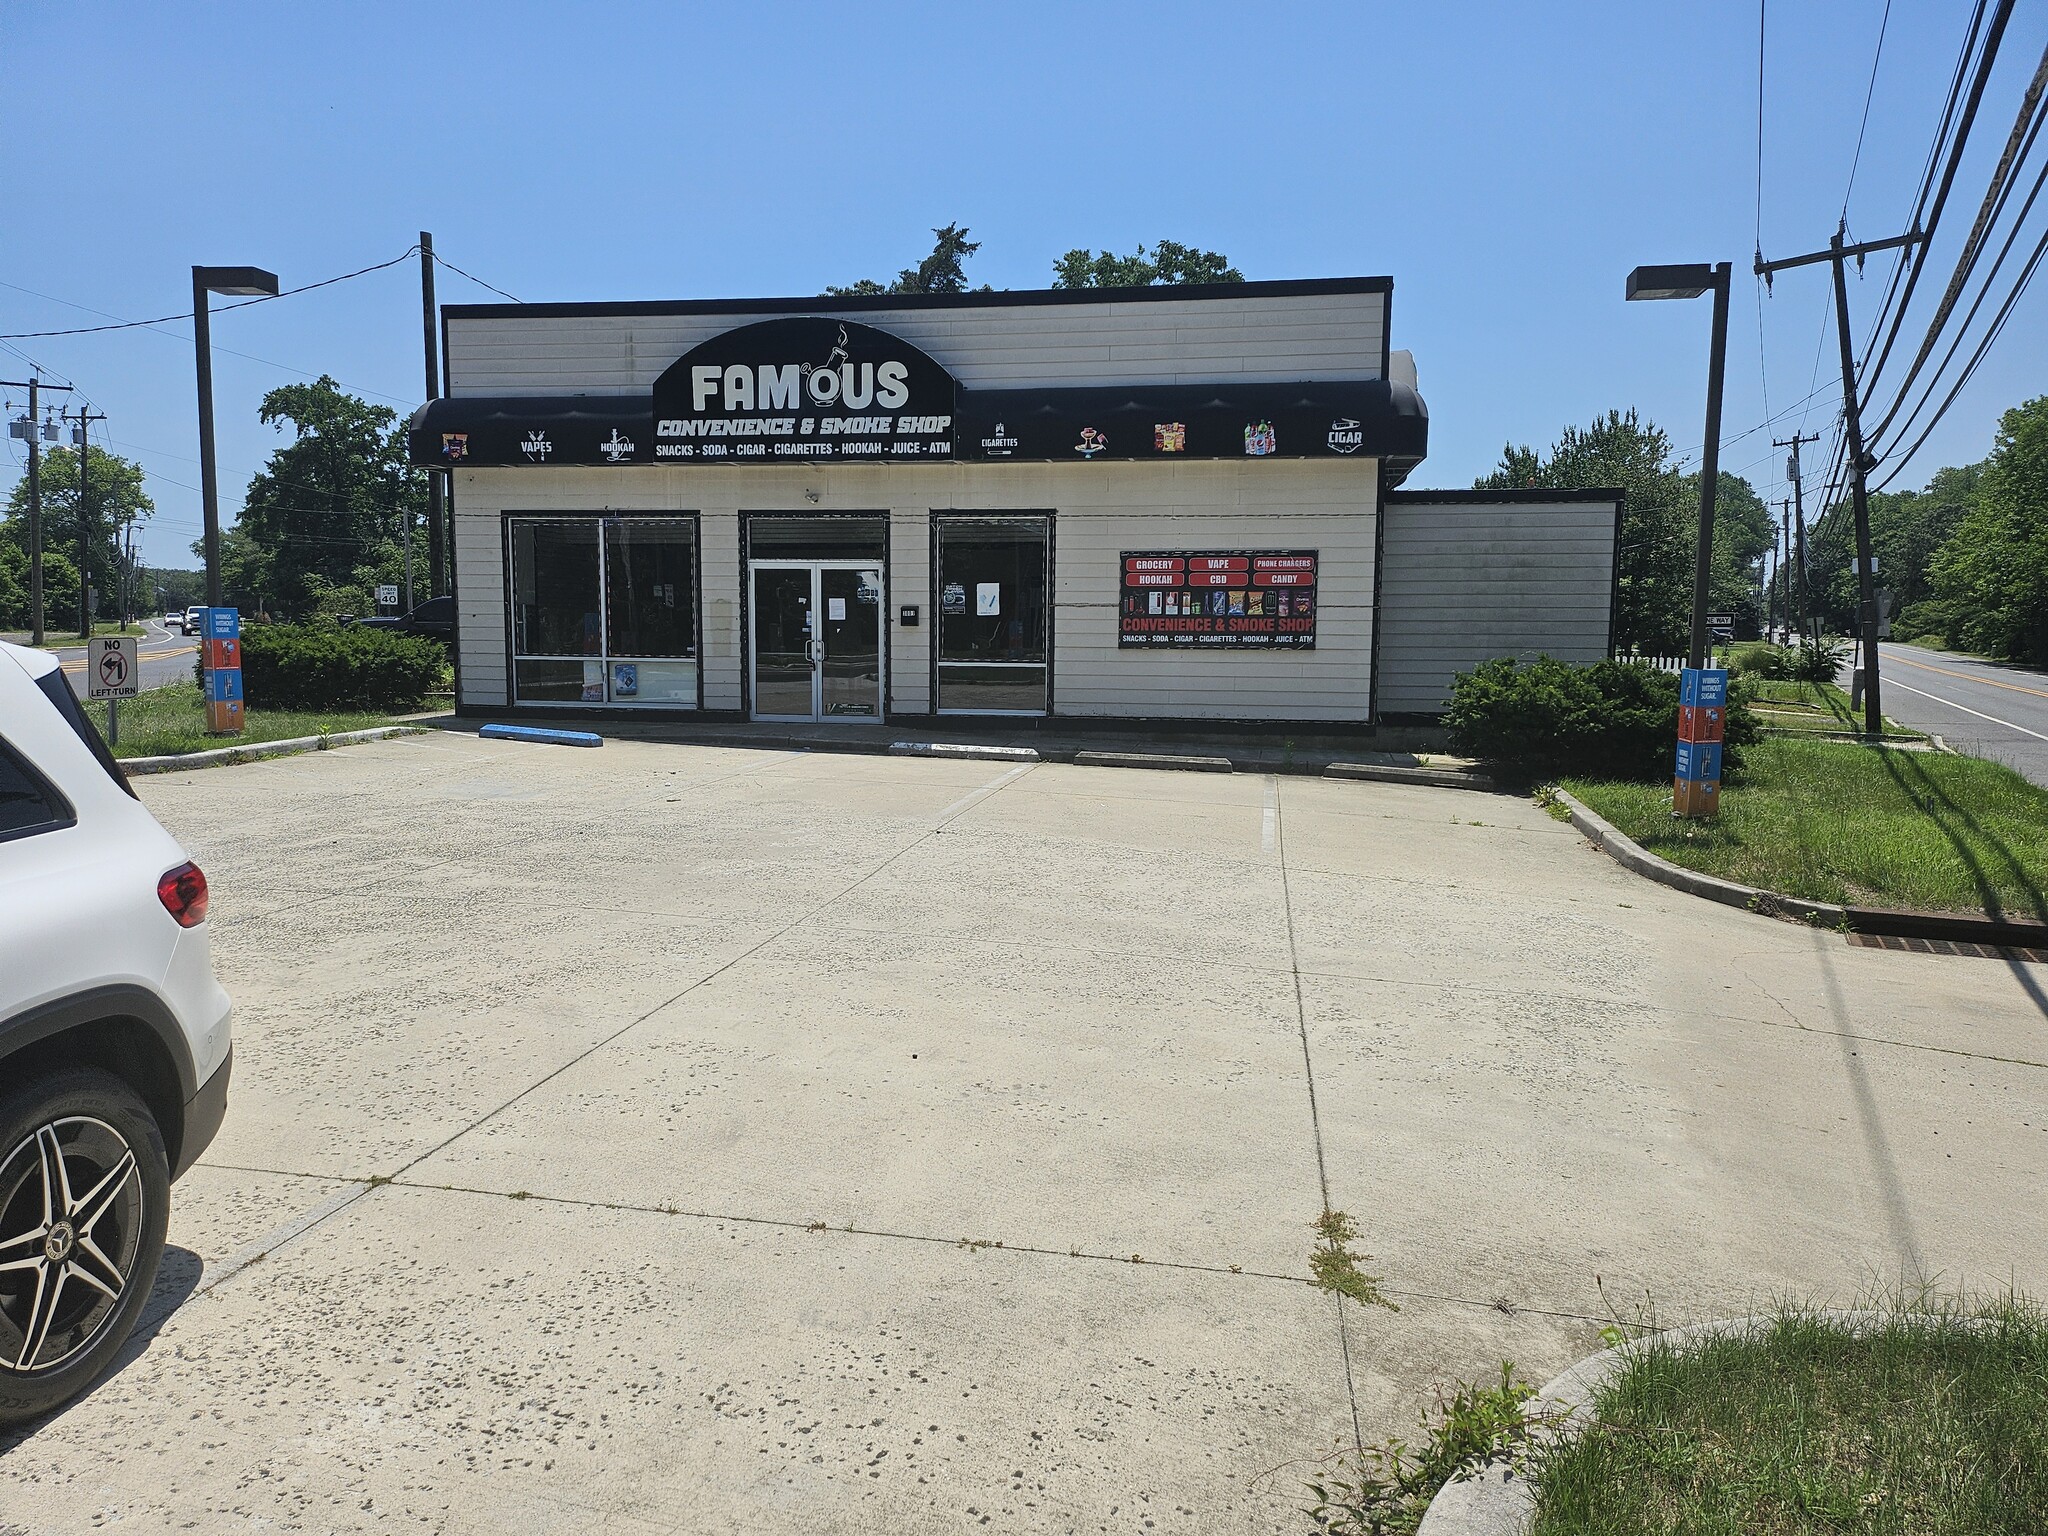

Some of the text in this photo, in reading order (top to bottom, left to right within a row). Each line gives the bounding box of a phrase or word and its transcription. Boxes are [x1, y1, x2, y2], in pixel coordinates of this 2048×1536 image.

[691, 361, 909, 411] FAMOUS
[656, 415, 952, 437] CONVENIENCE & SMOKE SHOP
[981, 438, 1018, 447] CIGARETTES
[1327, 431, 1363, 444] CIGAR
[520, 441, 553, 453] VAPES
[600, 442, 635, 452] HOOKAH
[656, 444, 694, 456] SNACKS
[702, 444, 728, 456] SODA
[736, 443, 766, 455] CIGAR
[774, 443, 833, 455] CIGARETTES
[841, 442, 882, 455] HOOKAH
[891, 442, 920, 454] JUICE
[929, 441, 951, 454] ATM
[1136, 560, 1173, 570] GROCERY
[1207, 559, 1229, 569] VAPE
[1139, 575, 1173, 585] HOOKAH
[1209, 575, 1227, 584] CBD
[1271, 574, 1298, 584] CANDY
[381, 595, 396, 604] 40
[1122, 617, 1312, 632] CONVENIENCE & SMOKE SHOP
[104, 640, 121, 650] NO
[91, 687, 136, 697] LEFT TURN
[1701, 684, 1722, 692] WITHOUT
